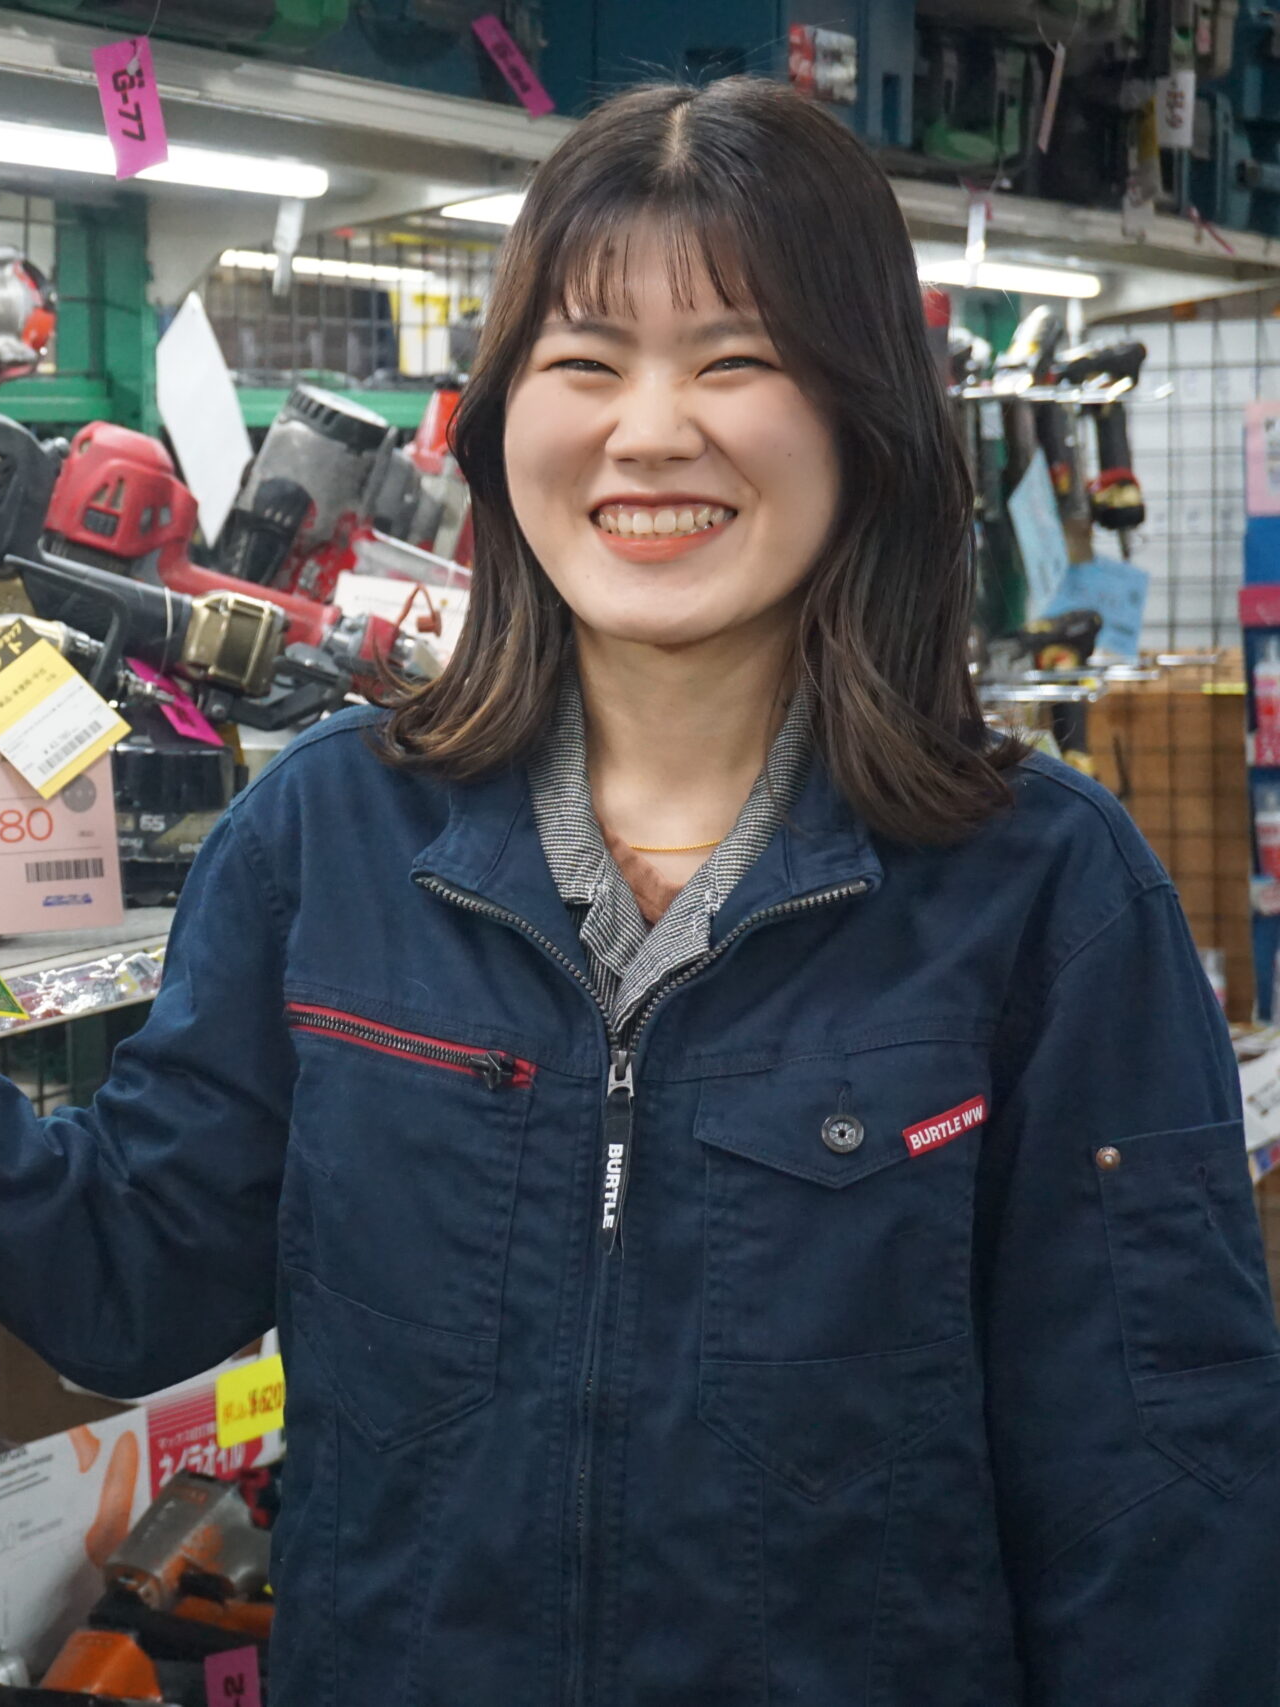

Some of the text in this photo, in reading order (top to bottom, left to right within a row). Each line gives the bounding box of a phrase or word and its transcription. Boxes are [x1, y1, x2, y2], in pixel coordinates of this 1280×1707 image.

[909, 1105, 983, 1150] BURTLE WW
[602, 1143, 624, 1229] BURTLE
